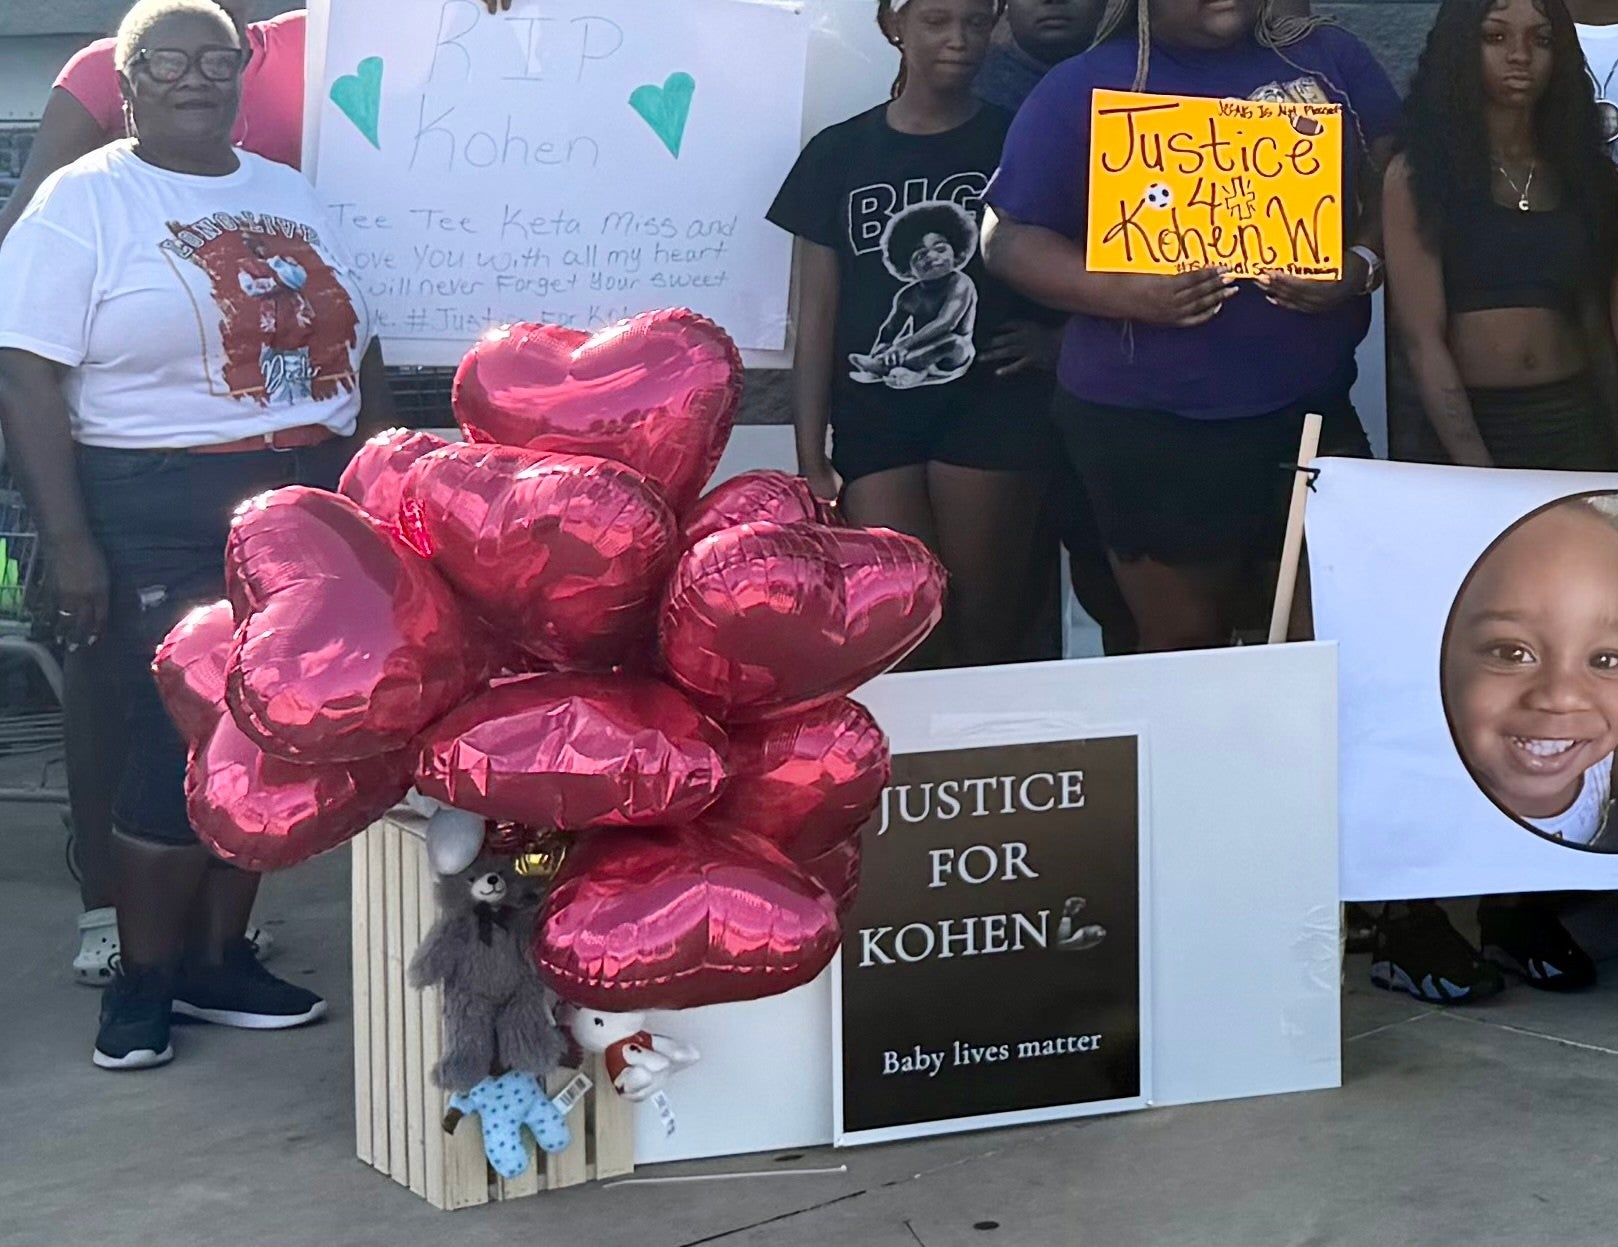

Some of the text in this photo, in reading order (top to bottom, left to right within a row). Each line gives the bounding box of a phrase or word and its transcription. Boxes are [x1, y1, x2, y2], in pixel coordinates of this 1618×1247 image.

[408, 93, 599, 172] Kohen
[1098, 102, 1321, 178] Justice
[328, 203, 393, 230] Tee
[409, 208, 479, 234] Tee
[500, 204, 581, 240] Keta
[686, 215, 738, 239] and
[1186, 176, 1223, 227] 4
[1102, 198, 1278, 264] Kohen
[353, 251, 397, 270] ove
[562, 244, 597, 267] all
[607, 247, 642, 273] my
[419, 277, 485, 297] never
[877, 770, 1086, 836] JUSTICE
[928, 841, 1040, 889] FOR
[858, 909, 1051, 968] KOHEN
[882, 1032, 1102, 1078] Baby lives matter
